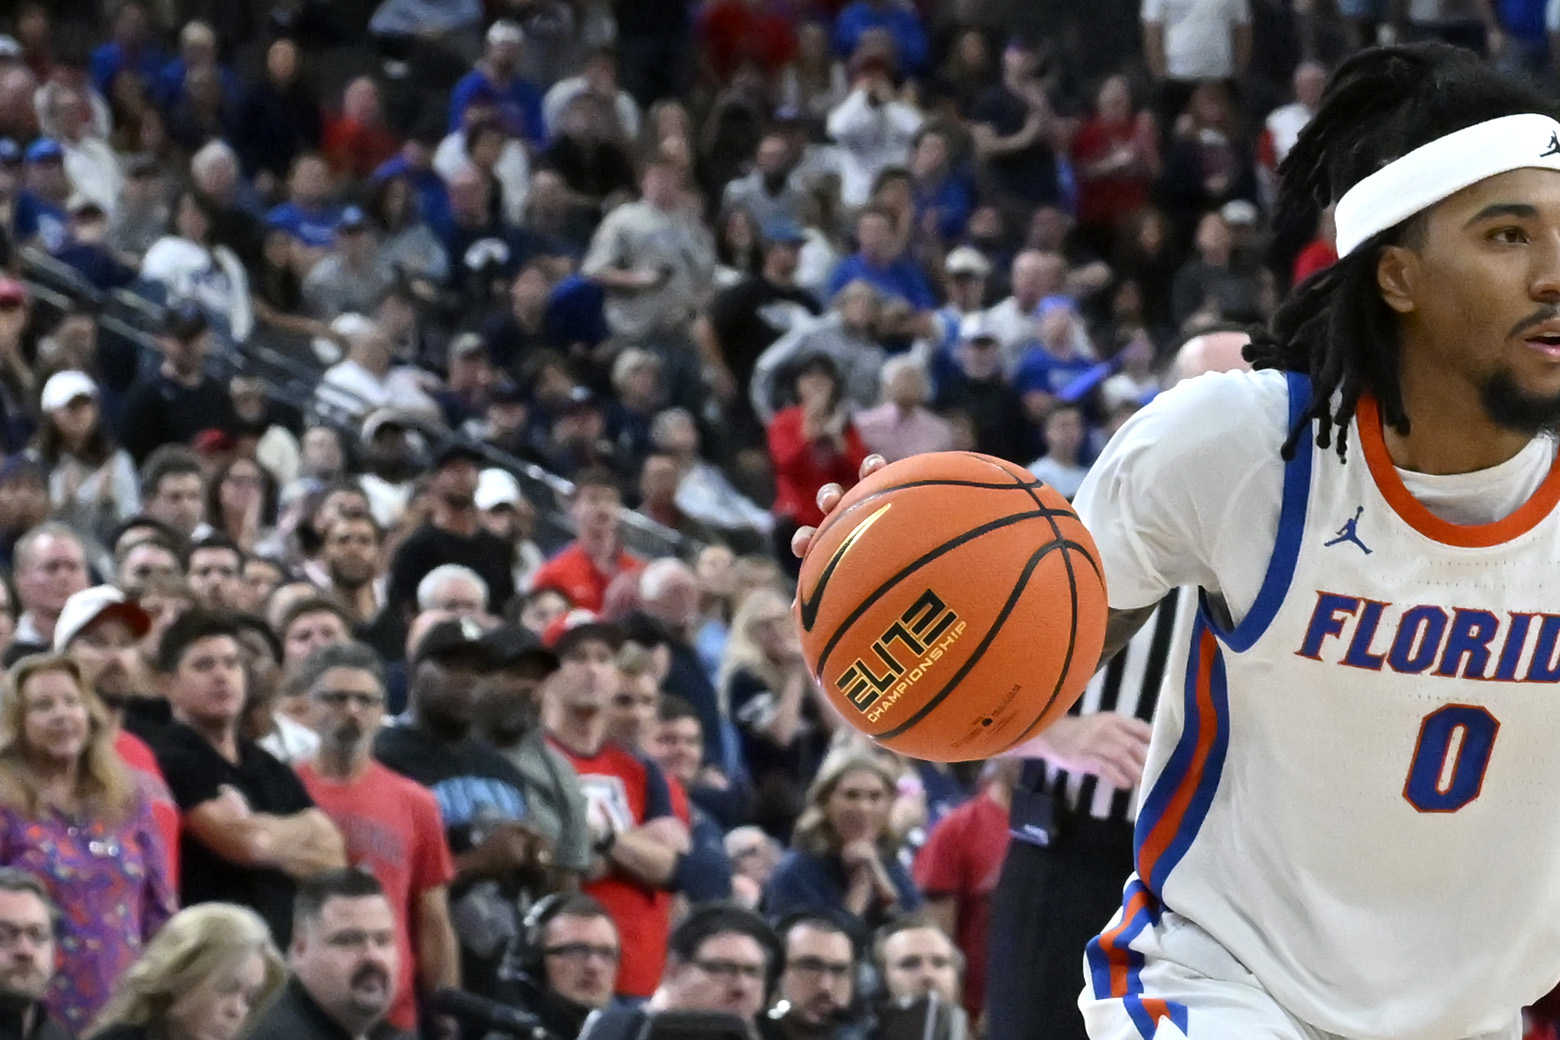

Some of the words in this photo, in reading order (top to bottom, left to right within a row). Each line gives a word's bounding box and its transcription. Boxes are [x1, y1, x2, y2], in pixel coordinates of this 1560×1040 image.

[835, 588, 959, 714] ELITE
[867, 620, 967, 723] CHAMPIONSHIP
[1402, 703, 1501, 813] 0
